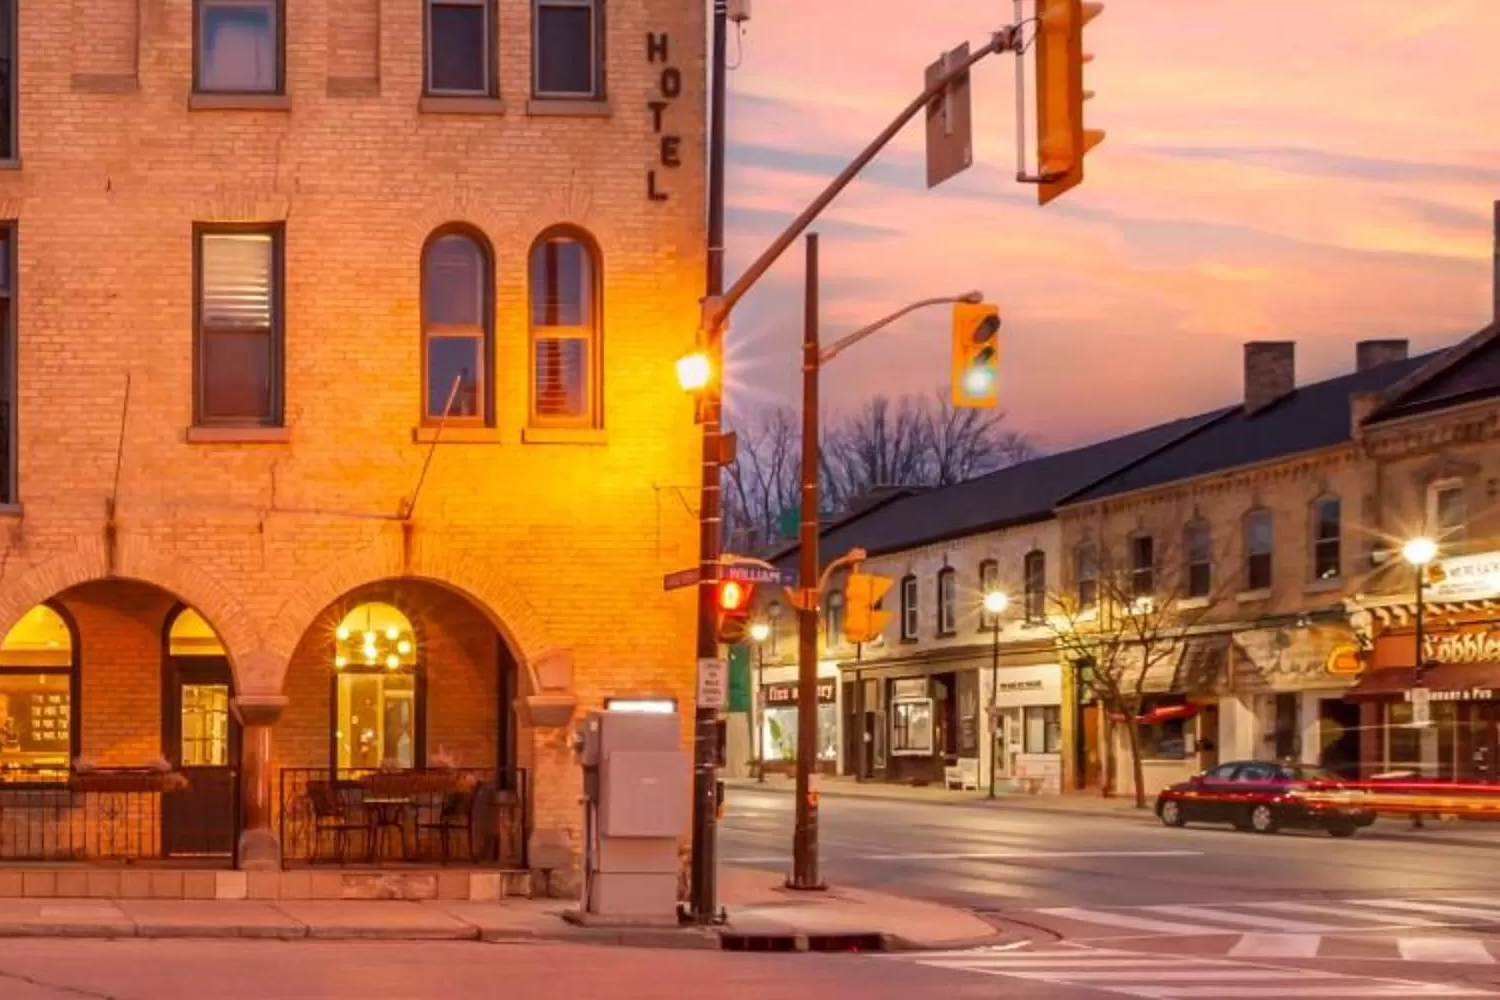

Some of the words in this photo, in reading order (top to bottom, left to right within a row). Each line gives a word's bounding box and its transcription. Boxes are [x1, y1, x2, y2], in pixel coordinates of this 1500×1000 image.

[646, 32, 681, 201] HOTEL
[728, 567, 781, 584] WILLIAM
[1421, 631, 1500, 664] Cobble
